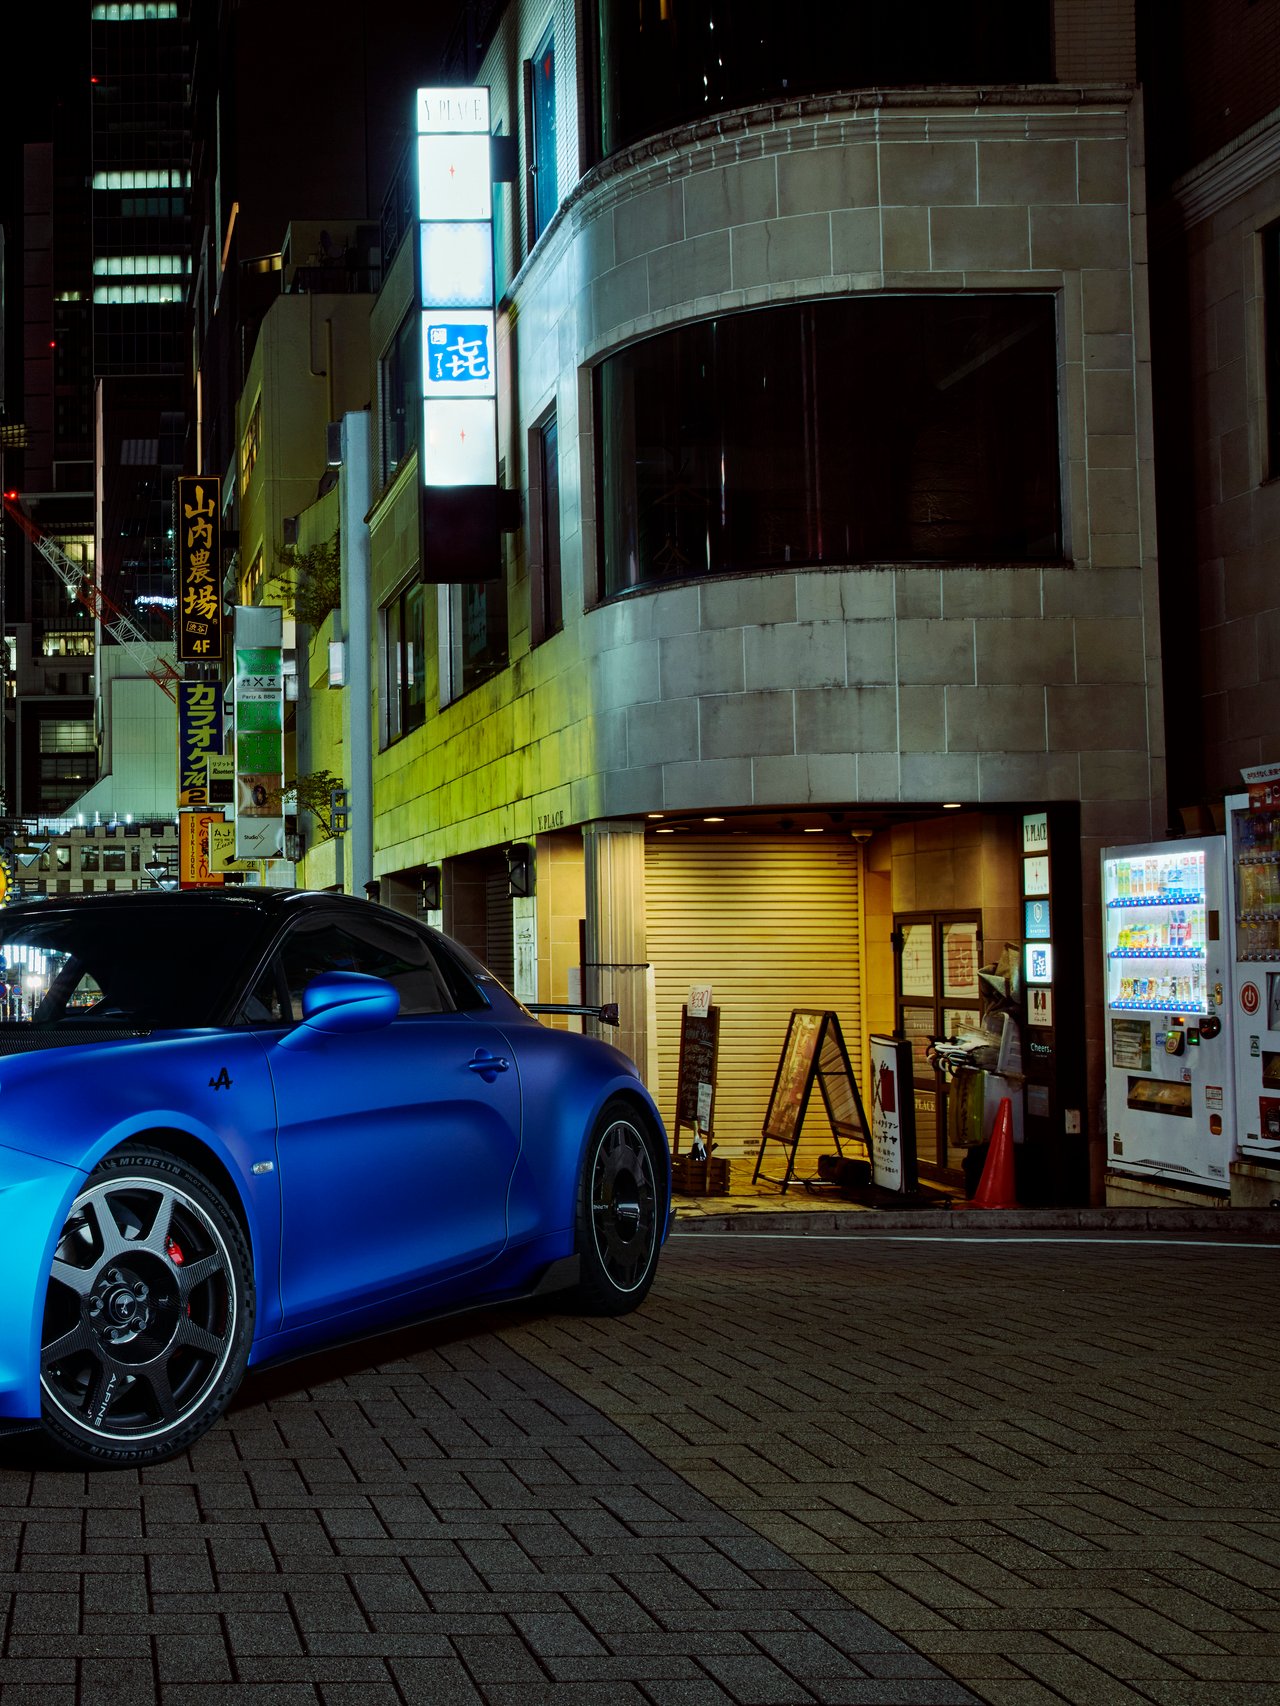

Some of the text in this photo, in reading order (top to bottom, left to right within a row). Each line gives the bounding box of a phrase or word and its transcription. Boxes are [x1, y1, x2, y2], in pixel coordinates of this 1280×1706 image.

[184, 484, 219, 621] 山内農場
[192, 640, 210, 653] 4F
[186, 684, 218, 770] カラオケ
[119, 1156, 181, 1175] MICHELIN
[94, 1372, 117, 1428] ALPINE
[88, 1446, 156, 1461] MICHELIN
